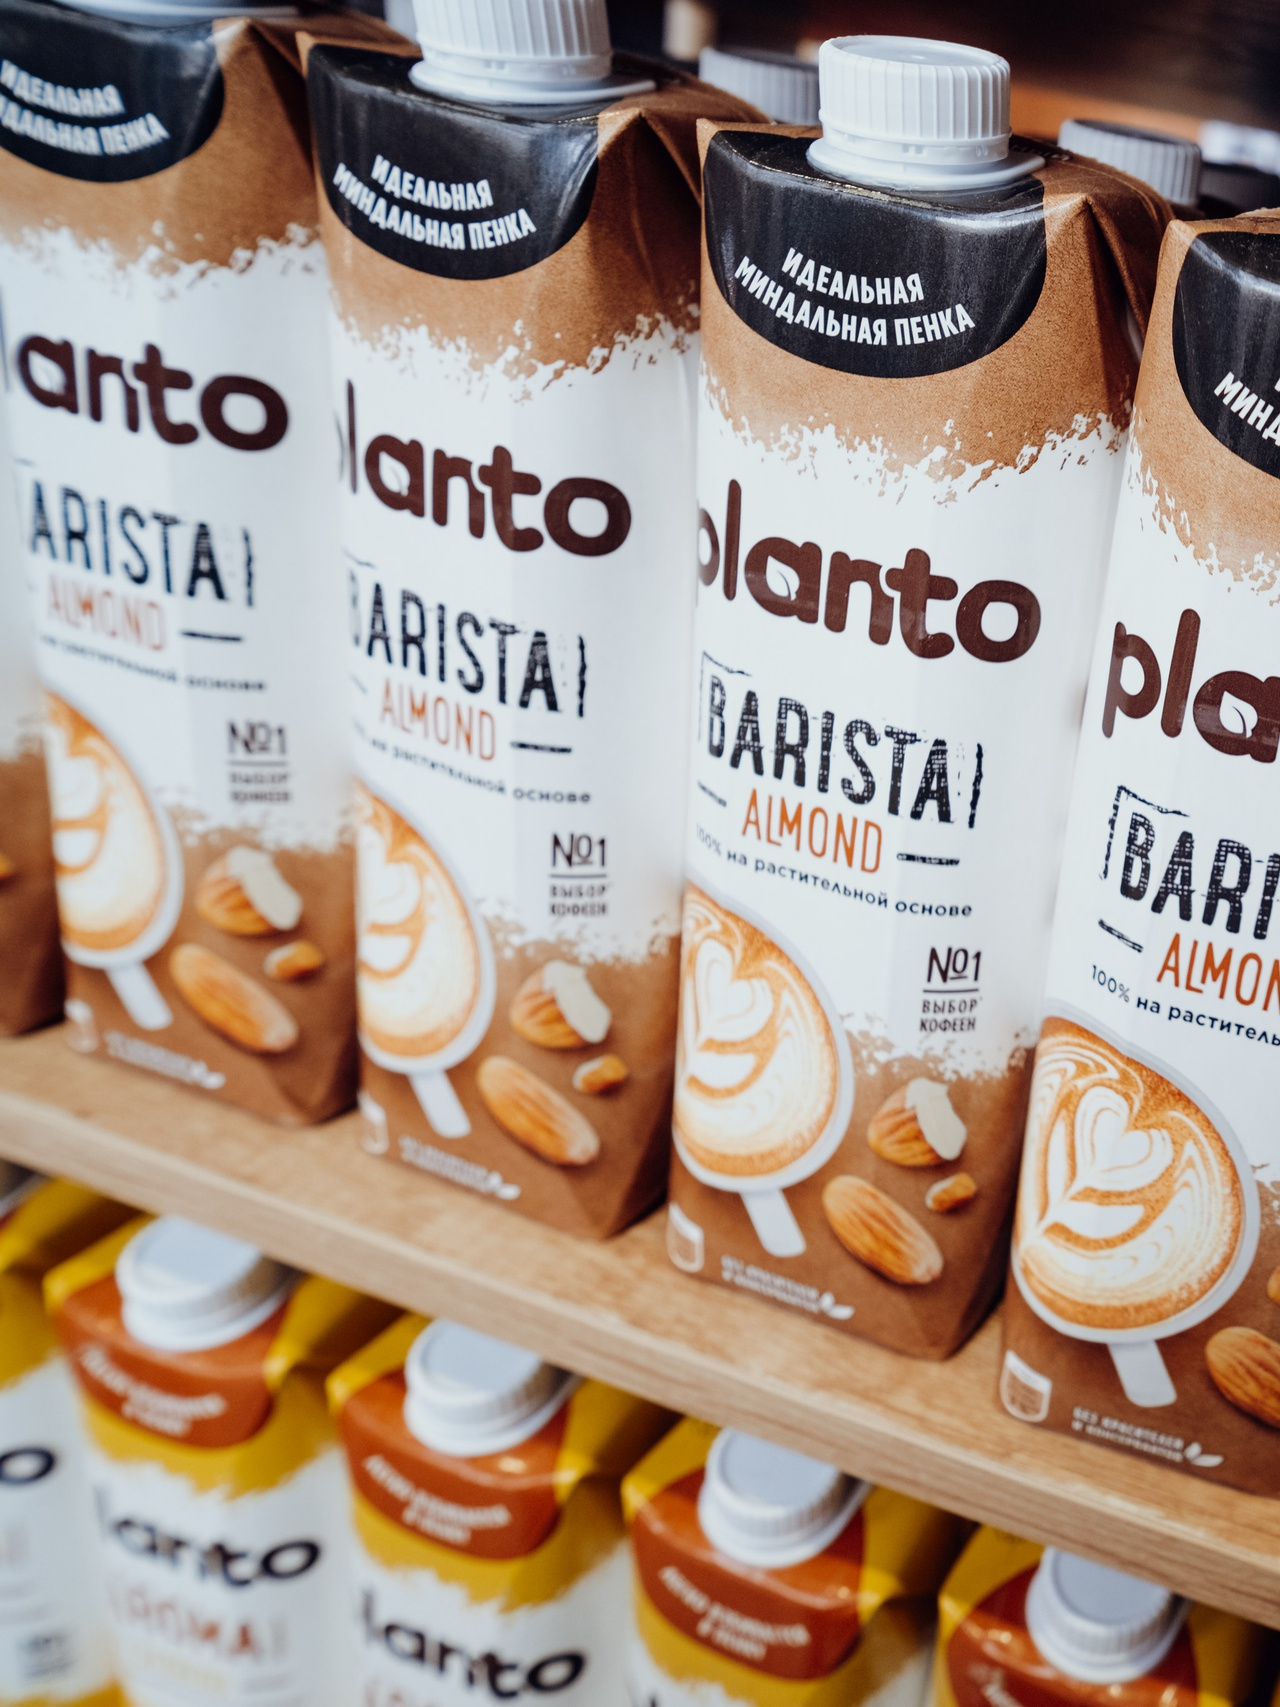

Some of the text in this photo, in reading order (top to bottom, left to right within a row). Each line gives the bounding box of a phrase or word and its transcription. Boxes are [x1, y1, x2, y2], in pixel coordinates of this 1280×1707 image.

[332, 162, 537, 250] МИНДАЛЬНАЯ ПЕНКА
[370, 154, 494, 212] ИДЕАЛЬНАЯ
[734, 255, 976, 346] МИНДАЛЬНАЯ ПЕНКА
[781, 247, 925, 305] ИДЕАЛЬНАЯ
[380, 678, 495, 762] ALMOND
[707, 675, 954, 824] BARISTA
[741, 788, 883, 874] ALMOND
[726, 849, 748, 867] на
[754, 857, 889, 909] растительной
[895, 901, 973, 917] основе
[919, 1016, 977, 1033] КОФЕЕН
[1090, 963, 1131, 1004] 100%
[1136, 995, 1162, 1014] на
